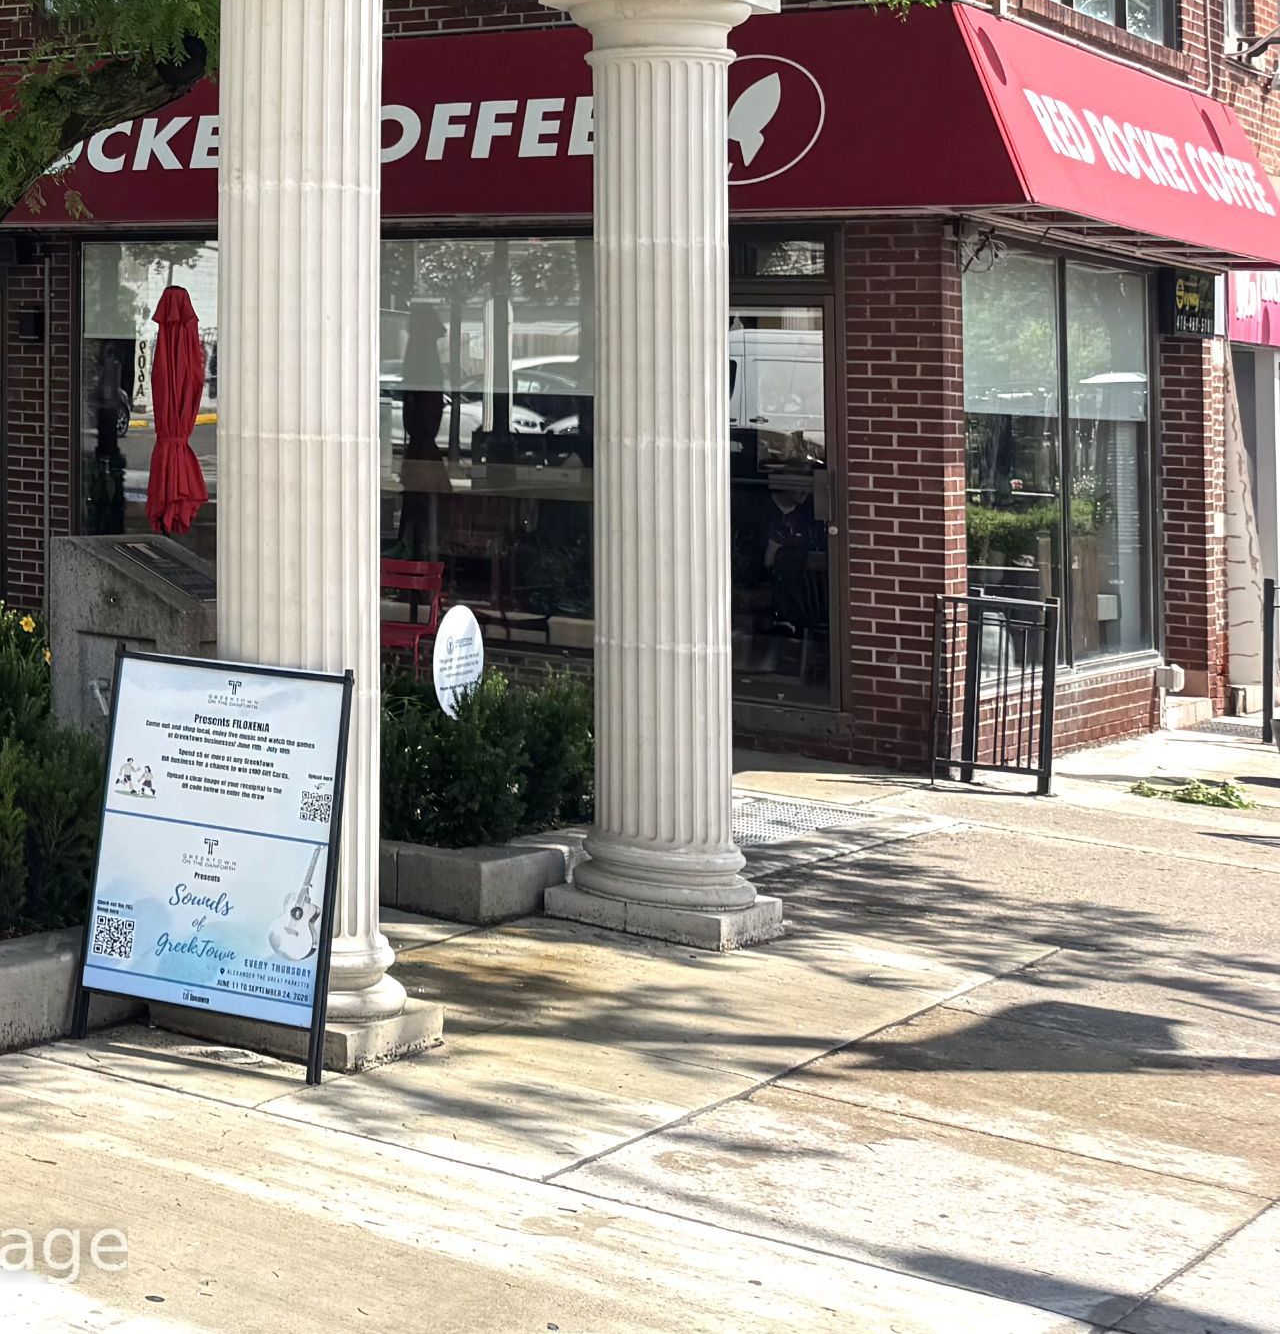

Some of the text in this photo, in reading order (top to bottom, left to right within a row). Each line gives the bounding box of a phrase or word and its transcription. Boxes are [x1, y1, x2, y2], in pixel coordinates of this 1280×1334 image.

[381, 96, 594, 164] OFFEE
[1023, 88, 1277, 217] RED ROCKET COFFEE
[193, 713, 270, 732] Presents FILOXENIA
[296, 741, 314, 749] games
[209, 762, 229, 770] chance
[194, 871, 220, 882] Presents
[169, 883, 234, 916] Sounds
[191, 915, 207, 933] of
[244, 958, 310, 978] EVERY THURSDAY
[240, 983, 247, 991] TO
[247, 984, 281, 997] SEPTEMBER
